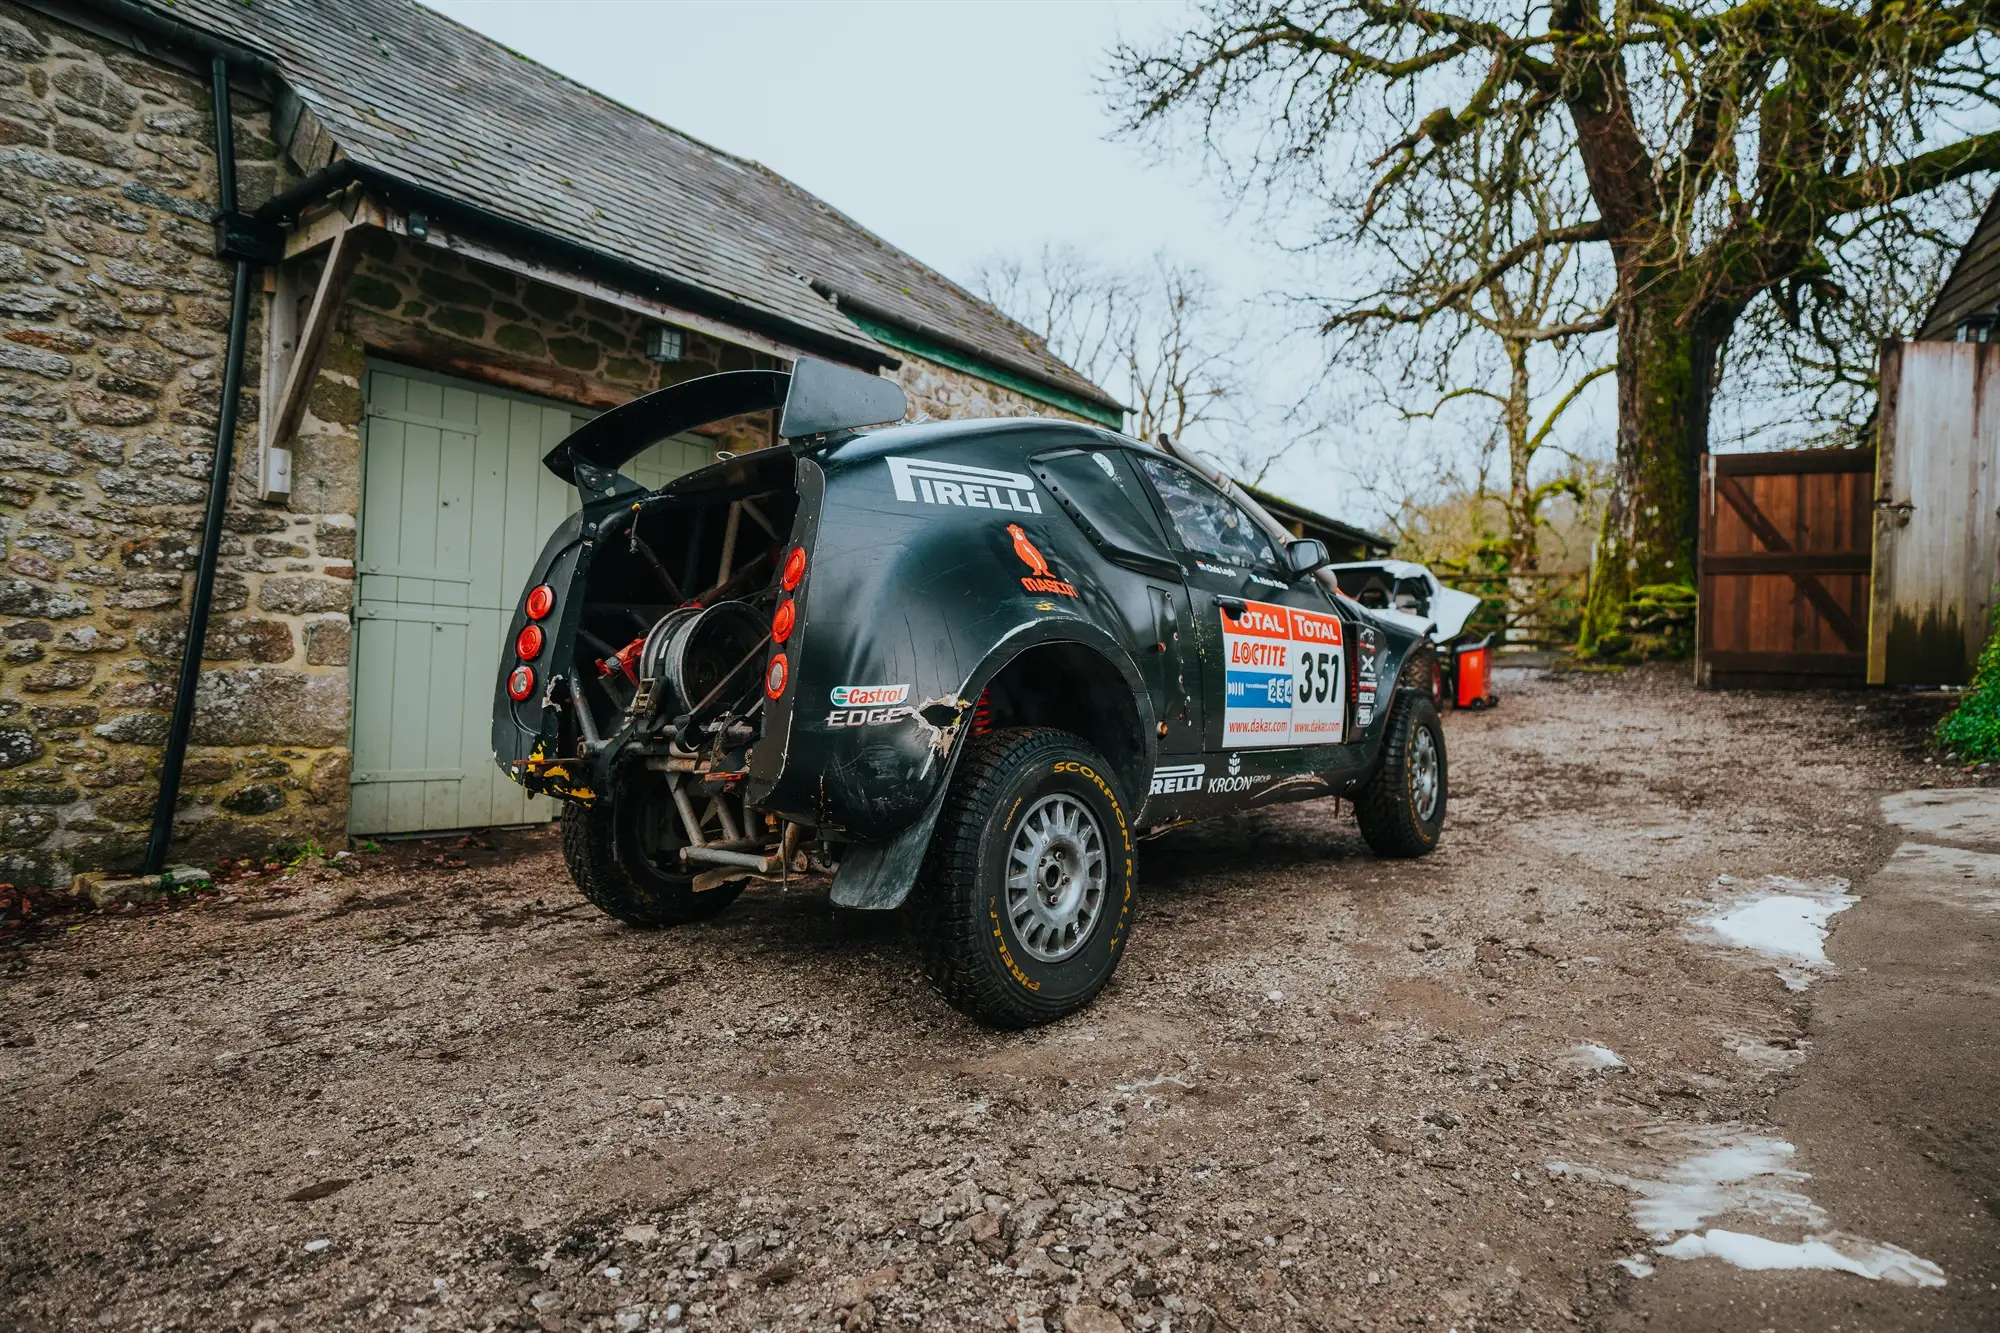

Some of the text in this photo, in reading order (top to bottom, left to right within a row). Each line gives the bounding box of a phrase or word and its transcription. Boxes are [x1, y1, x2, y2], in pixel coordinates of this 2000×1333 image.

[885, 456, 1042, 514] PIRELLI
[1021, 577, 1078, 598] MASCOT
[1294, 614, 1338, 640] TOTAL
[1232, 641, 1286, 667] LOCTITE
[1300, 651, 1339, 703] 351
[849, 687, 904, 704] Castrol
[824, 707, 904, 727] EDGE
[1229, 719, 1288, 733] www.dakar.com
[1294, 720, 1340, 733] www.dakar.com
[1208, 774, 1271, 793] KROON GROUP
[1053, 761, 1131, 851] SCORPION
[989, 910, 1040, 991] PIRELLI
